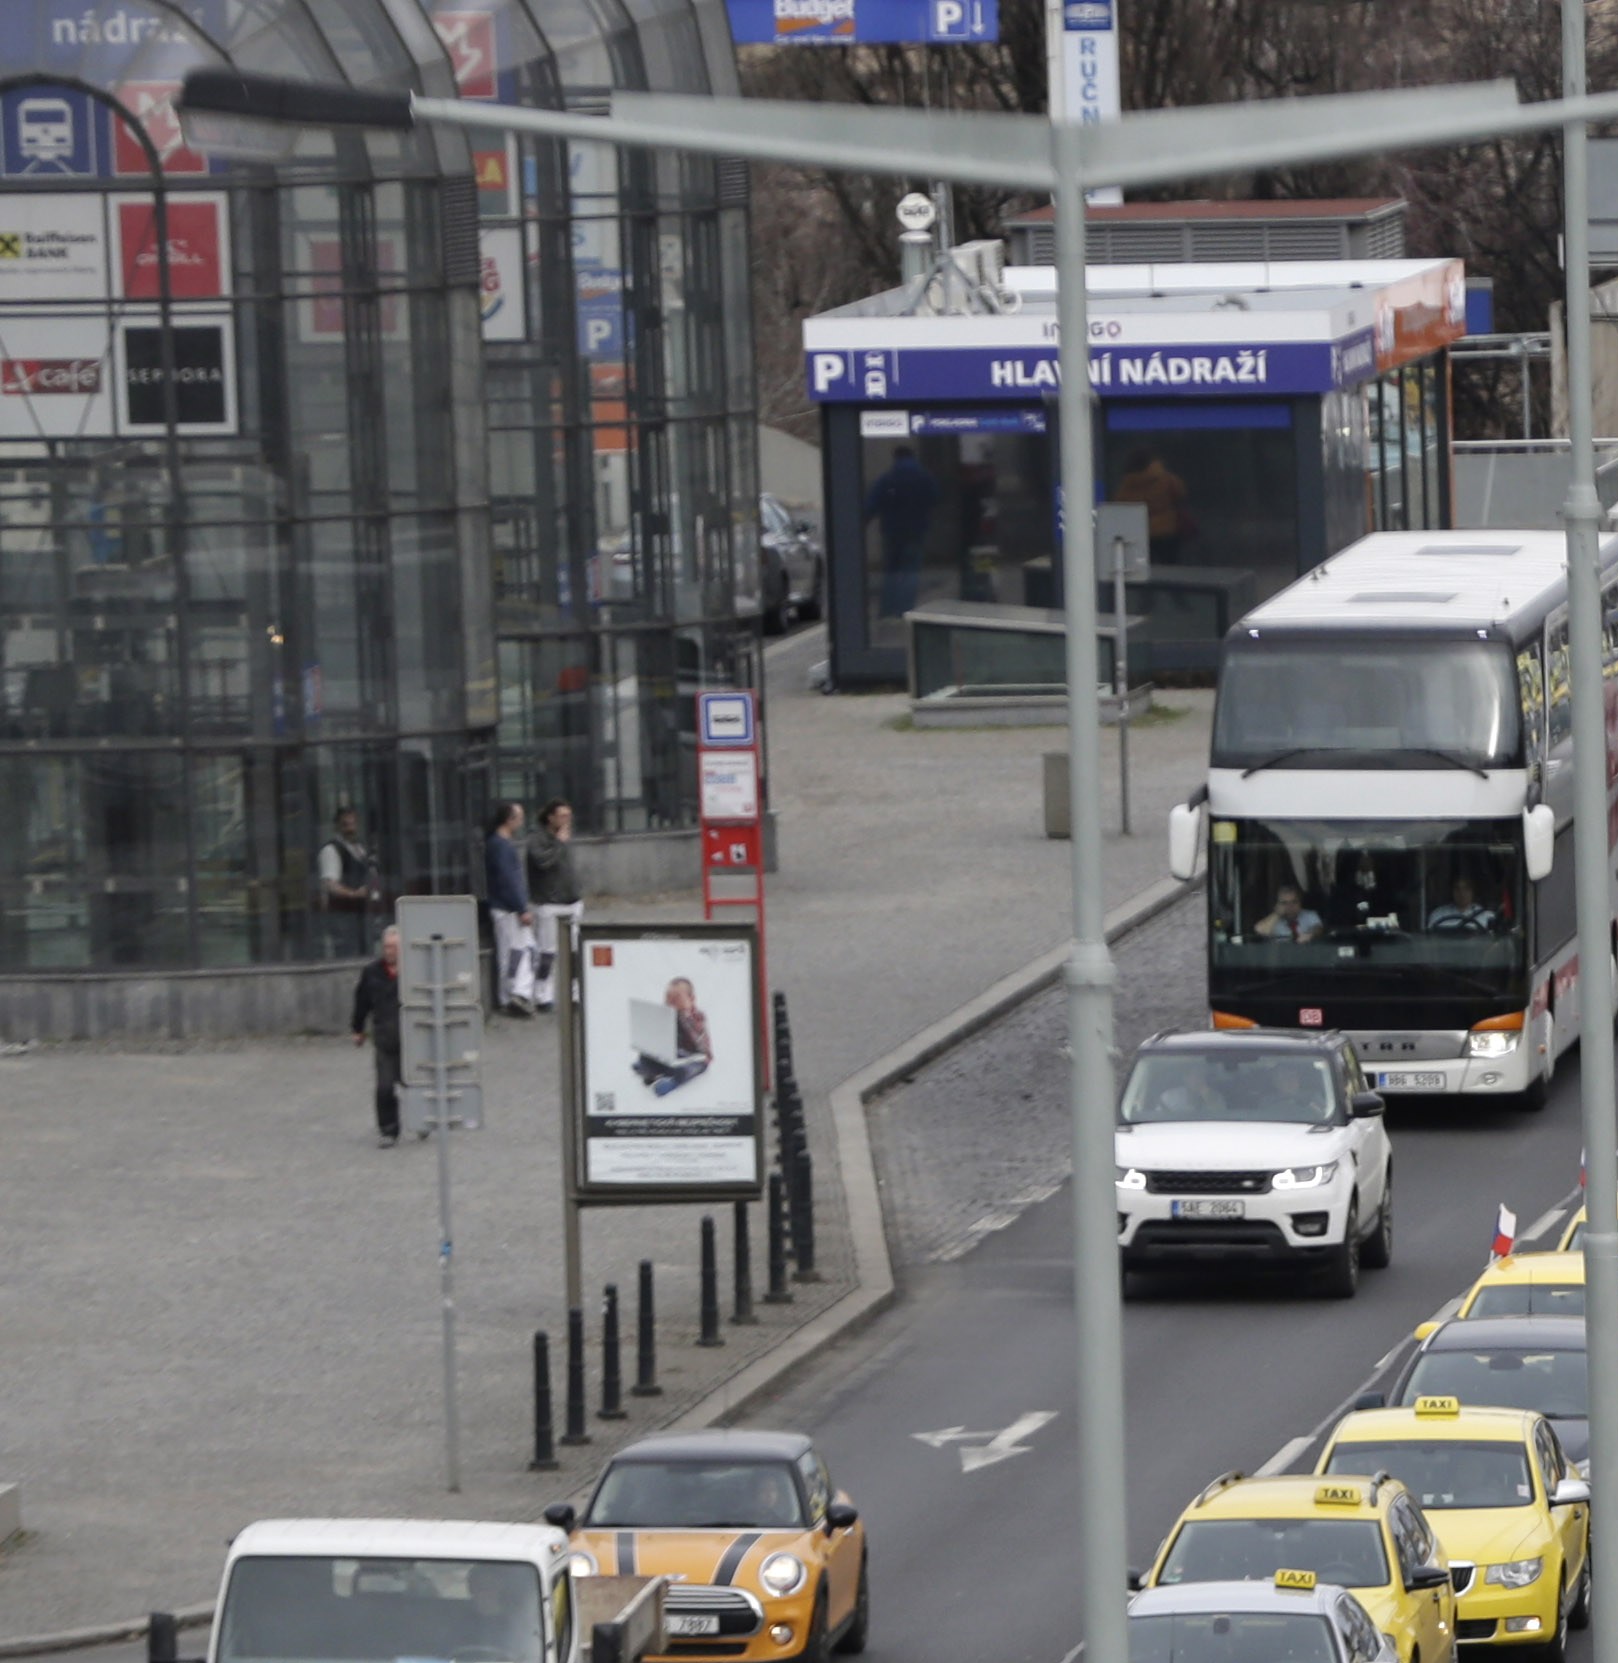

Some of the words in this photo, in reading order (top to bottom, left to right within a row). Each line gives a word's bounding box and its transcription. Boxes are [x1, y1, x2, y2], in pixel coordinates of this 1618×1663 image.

[25, 246, 69, 259] BANK
[1042, 322, 1122, 339] INGO
[814, 354, 845, 391] P
[1120, 348, 1268, 385] NÁDRAŽÍ
[127, 367, 222, 384] SEPORA
[1423, 1401, 1451, 1409] TAXI
[1324, 1489, 1353, 1499] TAXI
[1280, 1571, 1313, 1584] TAXI
